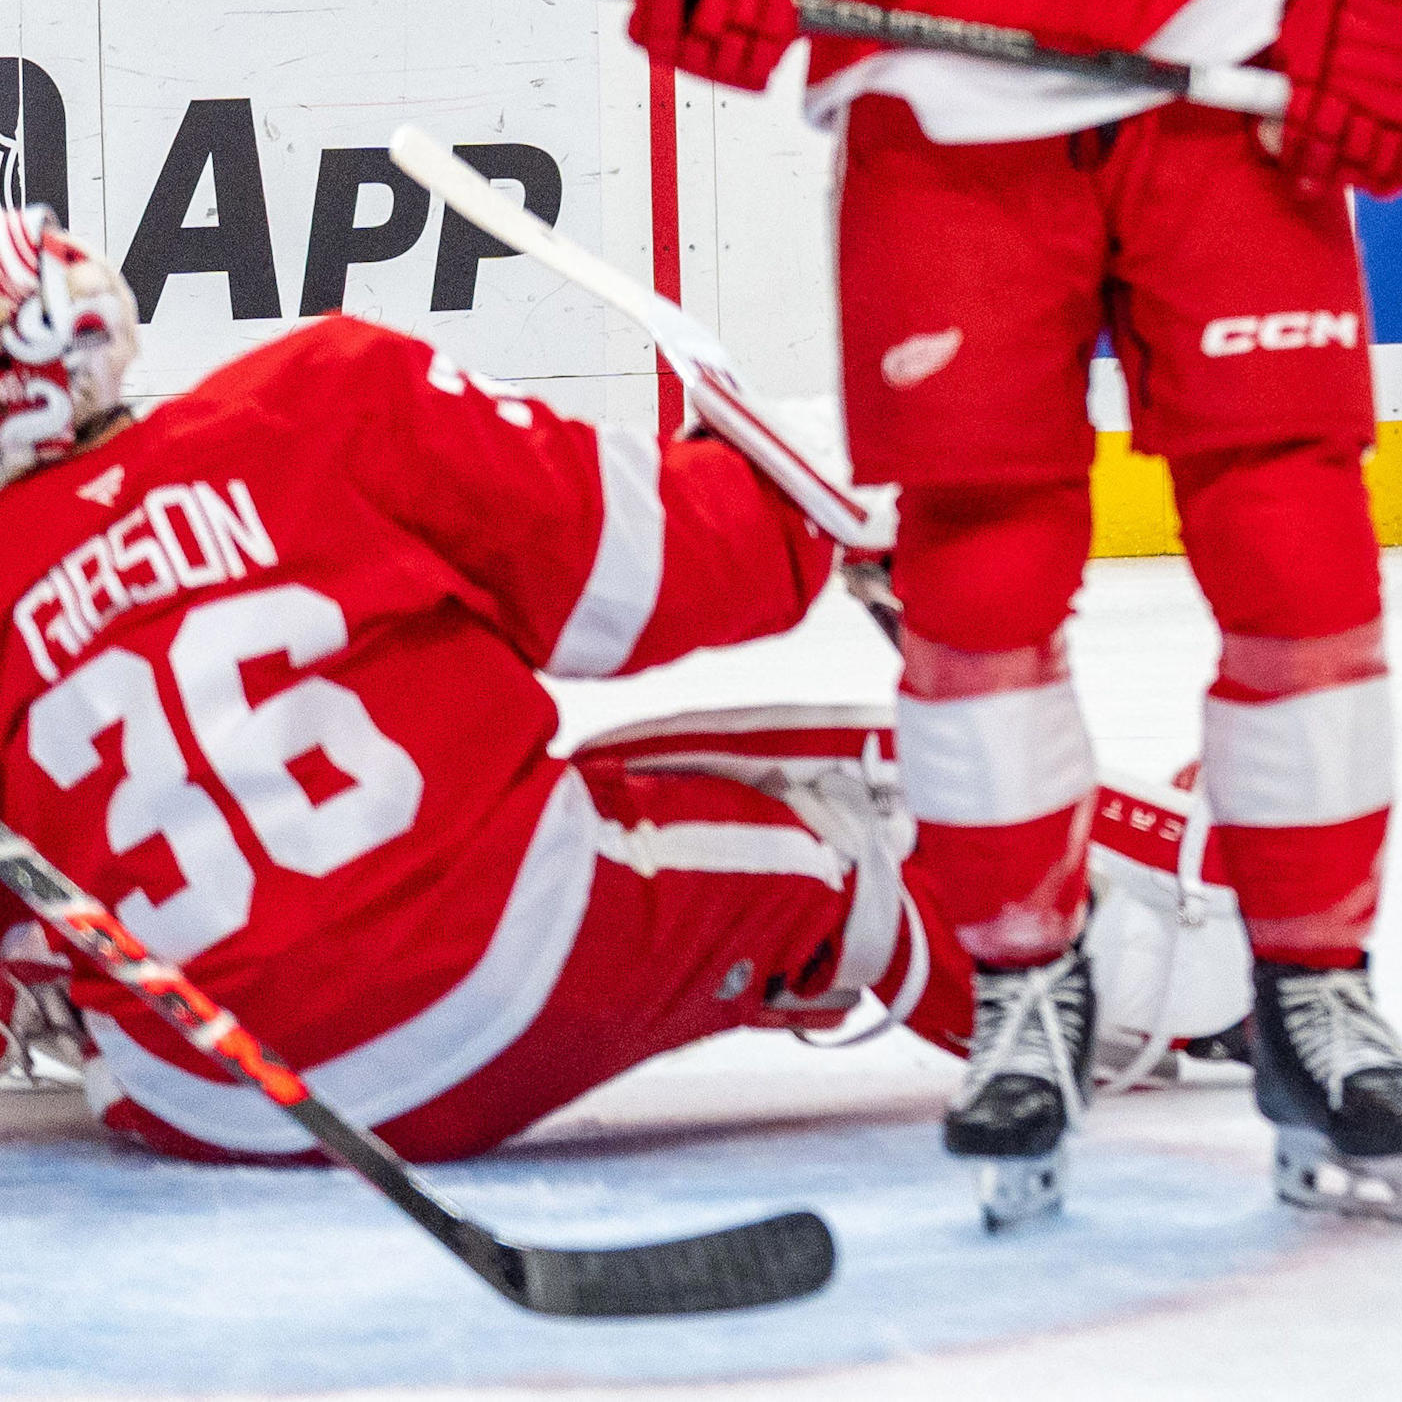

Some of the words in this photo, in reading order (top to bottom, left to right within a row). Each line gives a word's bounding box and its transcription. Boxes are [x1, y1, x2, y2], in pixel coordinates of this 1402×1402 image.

[1200, 310, 1359, 359] CCM
[12, 477, 279, 683] GIBSON
[28, 582, 425, 967] 36
